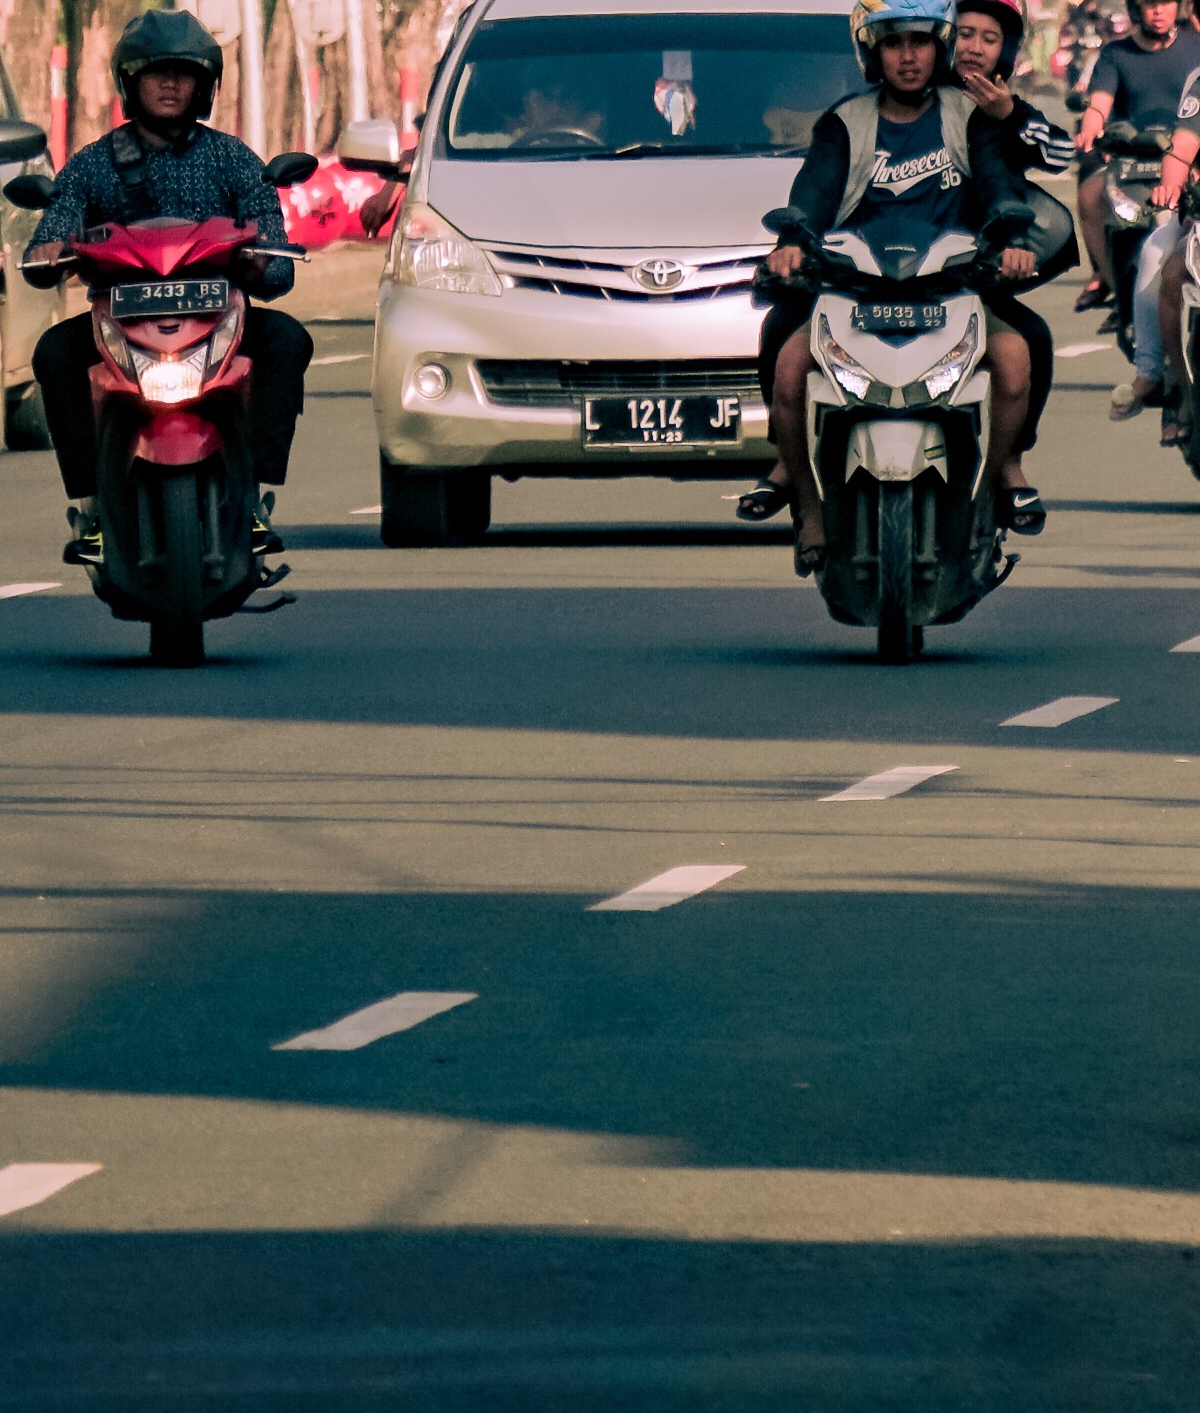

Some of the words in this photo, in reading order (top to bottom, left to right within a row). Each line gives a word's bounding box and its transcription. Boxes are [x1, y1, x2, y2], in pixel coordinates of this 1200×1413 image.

[870, 147, 950, 183] Threesecon
[115, 288, 124, 301] L
[142, 284, 185, 298] 3433
[200, 283, 221, 295] BS
[855, 306, 864, 318] L
[585, 400, 601, 431] L
[627, 399, 684, 429] 1214
[709, 398, 739, 428] JF
